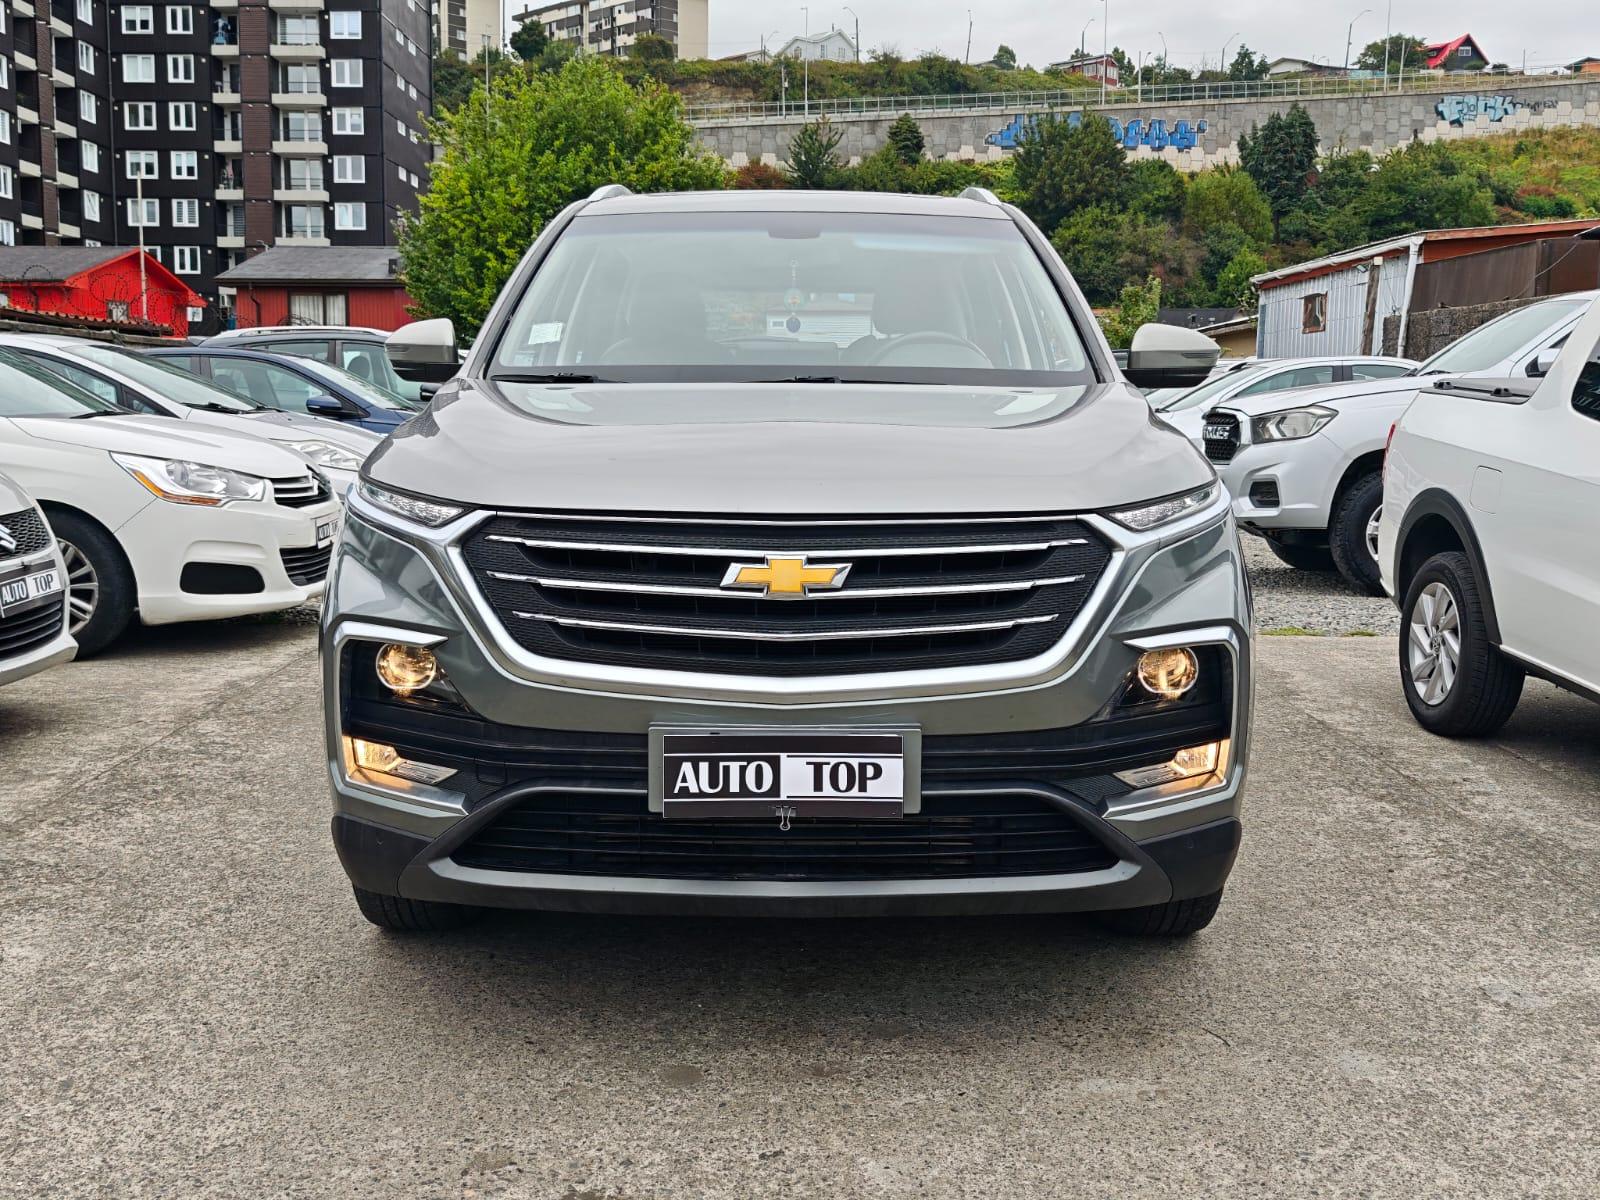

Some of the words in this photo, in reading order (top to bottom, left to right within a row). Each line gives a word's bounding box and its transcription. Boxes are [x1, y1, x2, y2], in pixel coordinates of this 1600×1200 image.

[2, 580, 27, 605] AUTO
[33, 573, 53, 593] TOP
[673, 760, 774, 794] AUTO
[806, 761, 883, 793] TOP
